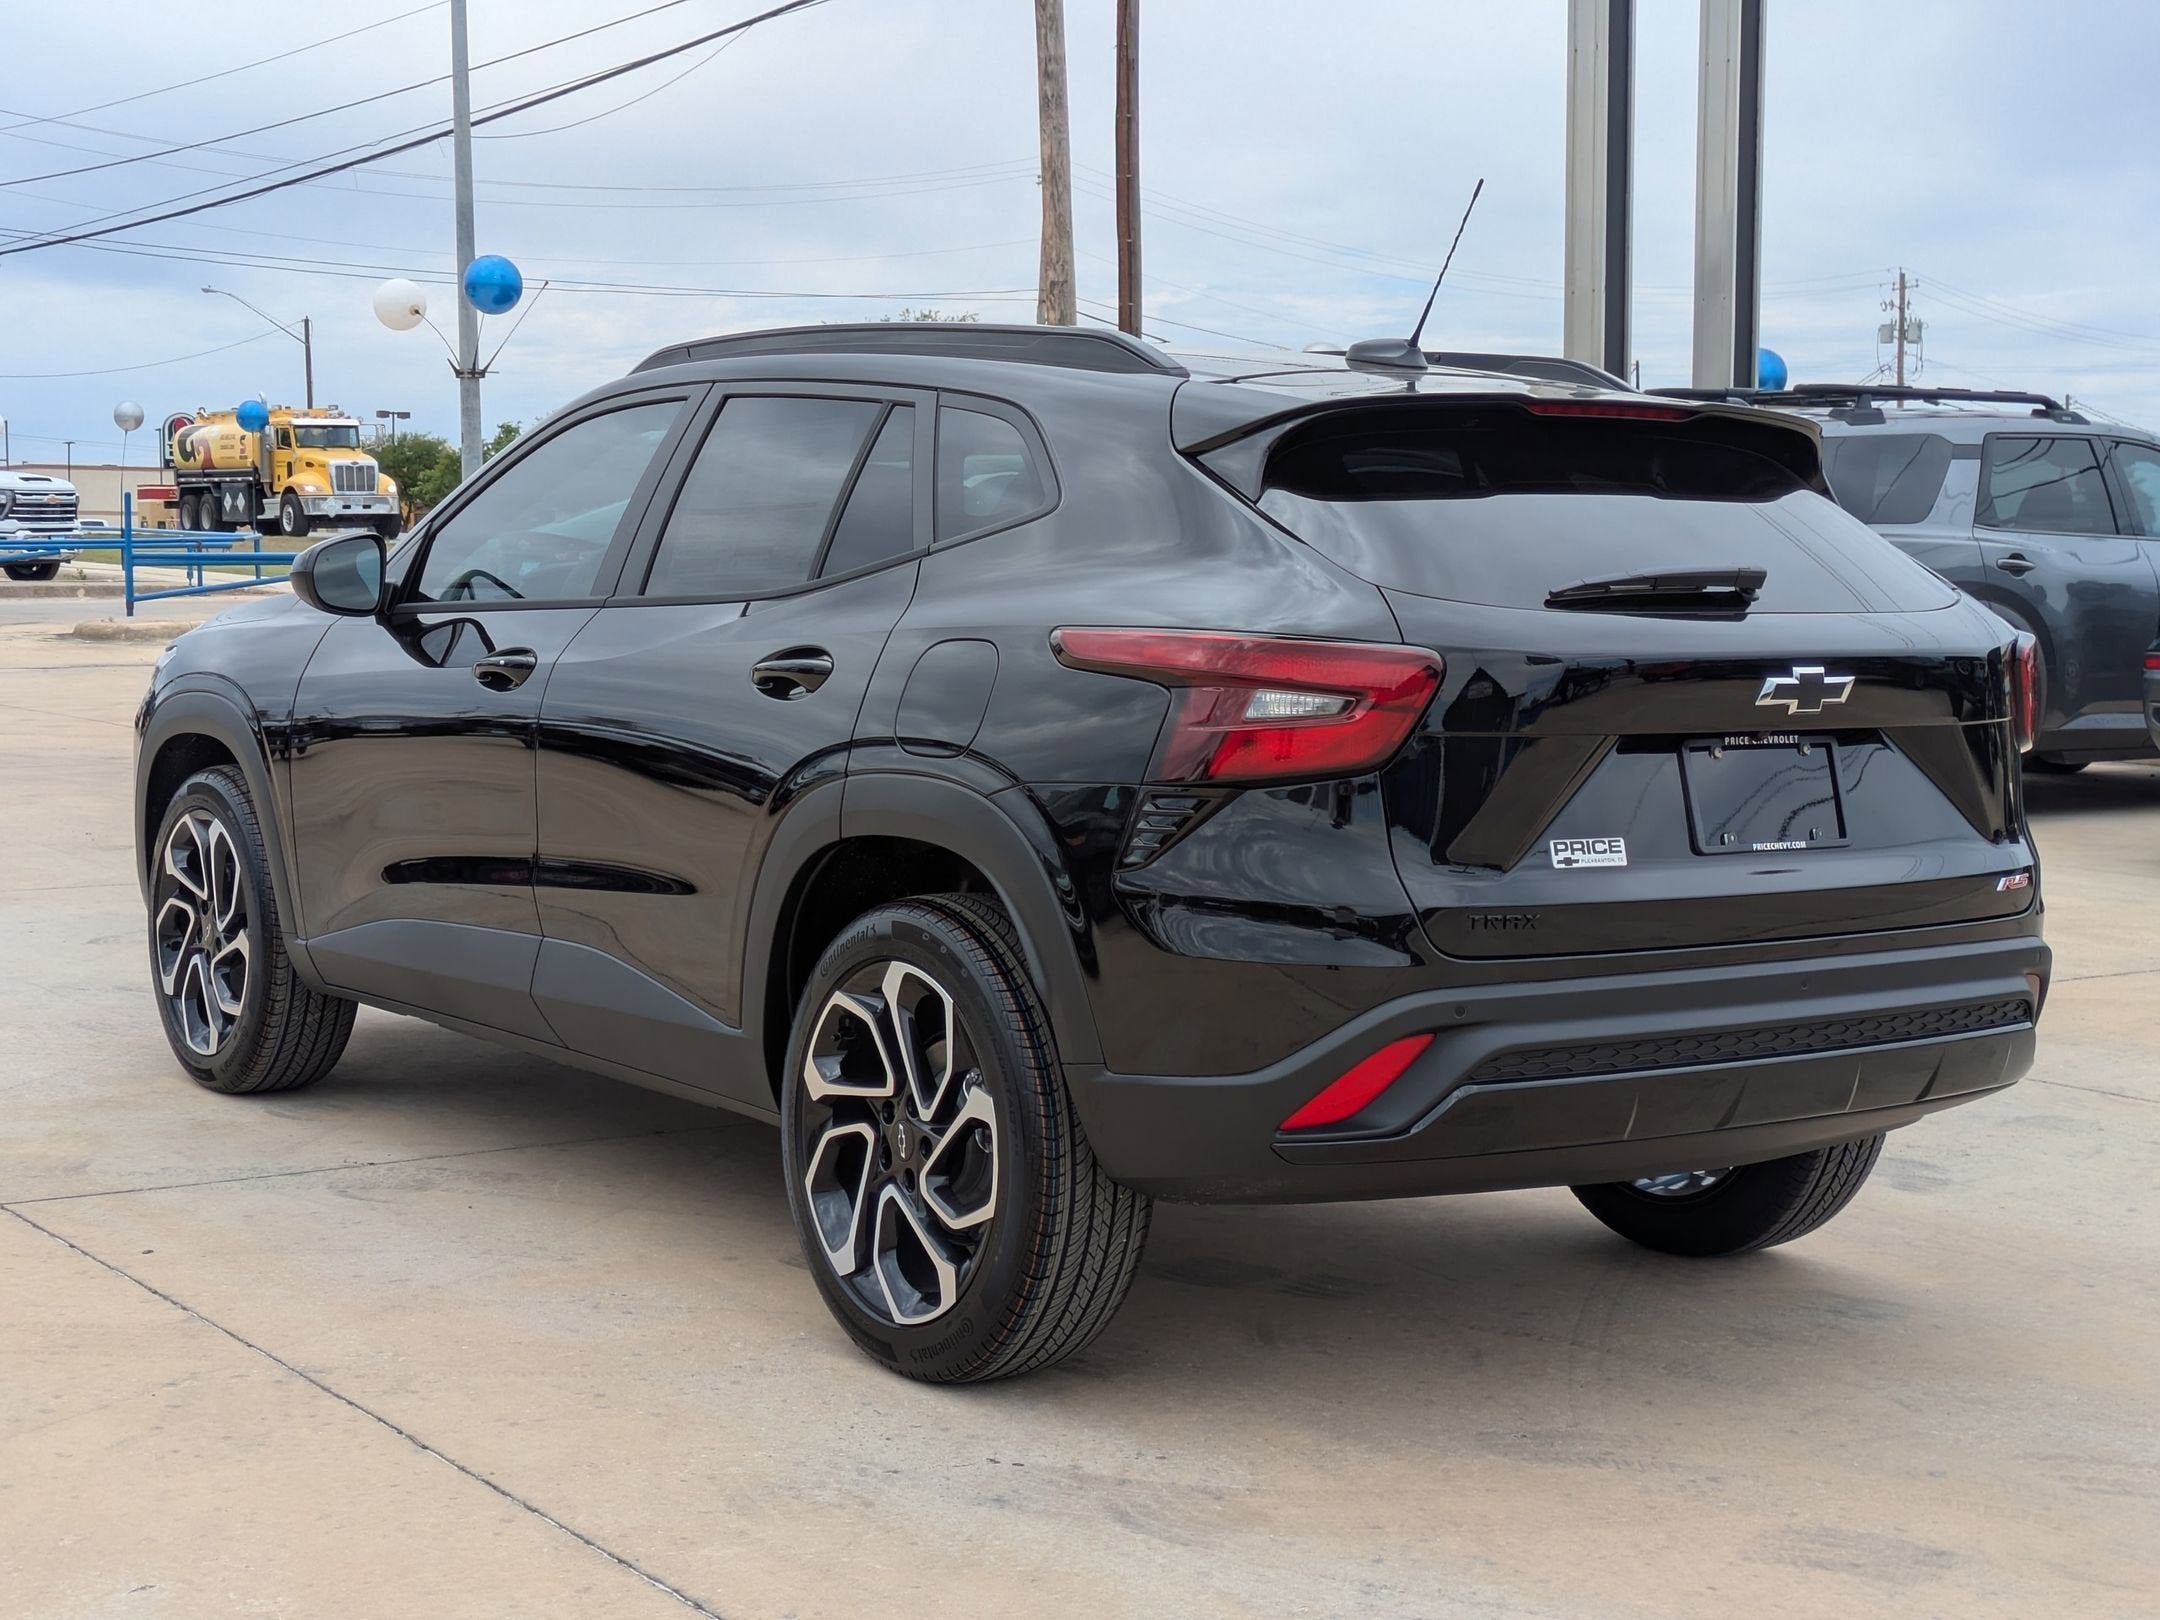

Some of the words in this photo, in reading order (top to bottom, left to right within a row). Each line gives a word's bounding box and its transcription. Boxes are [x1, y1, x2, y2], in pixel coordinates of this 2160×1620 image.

[1724, 736, 1750, 746] PRICE
[1552, 839, 1623, 857] PRICE
[1752, 840, 1807, 851] PRICECHEVY.COM
[1996, 872, 2030, 892] RS
[1467, 914, 1540, 930] TRAX
[819, 925, 871, 978] Continental
